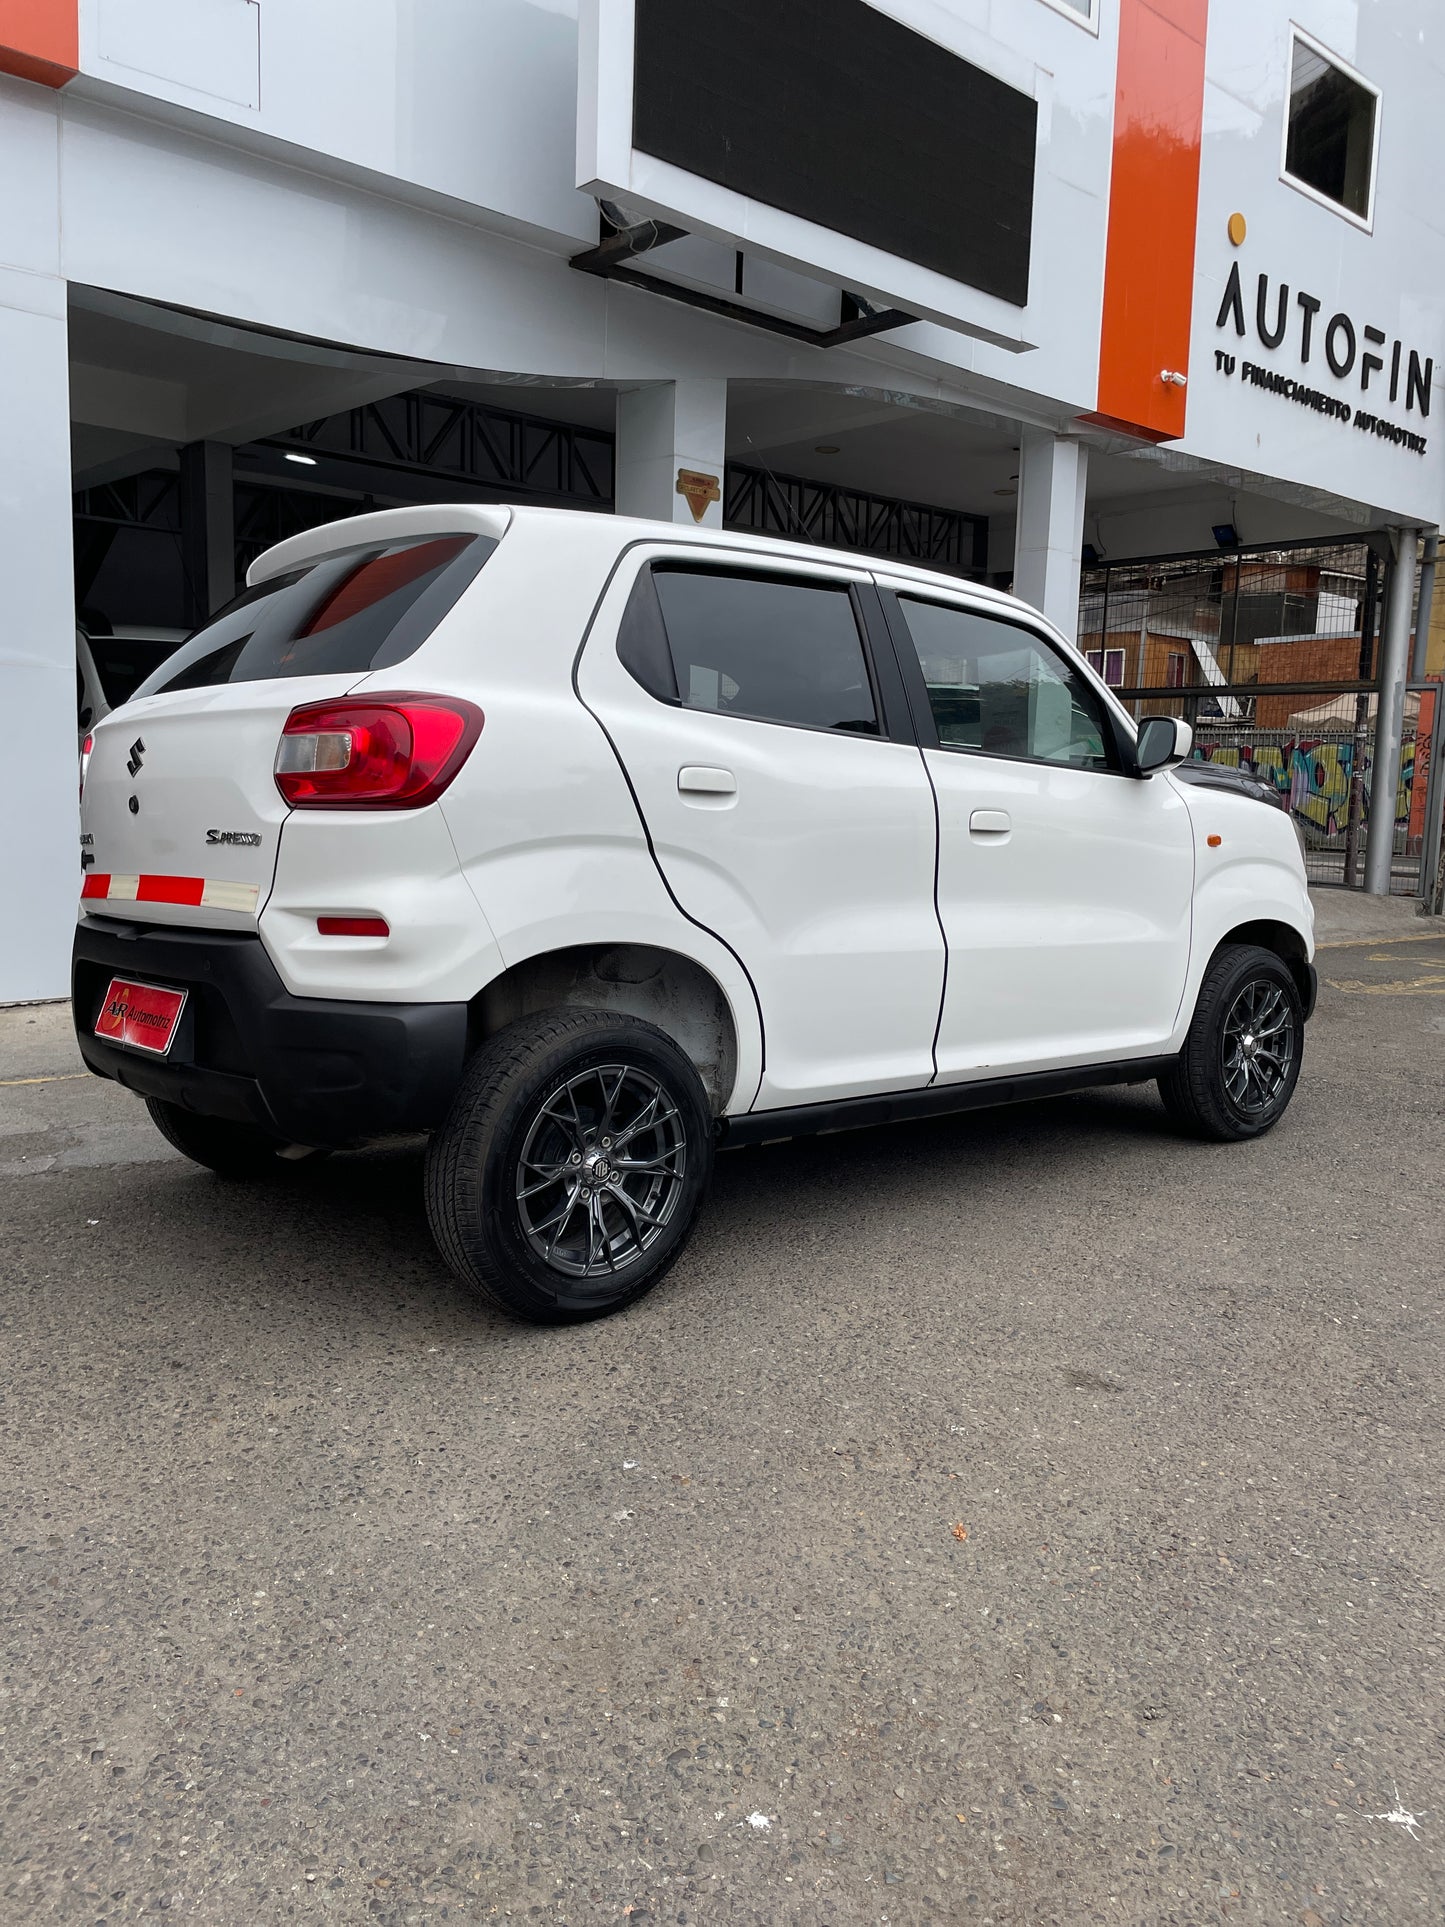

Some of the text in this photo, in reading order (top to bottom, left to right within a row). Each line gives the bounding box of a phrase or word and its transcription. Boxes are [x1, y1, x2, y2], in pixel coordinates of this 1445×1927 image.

[1215, 261, 1433, 417] AUTOFIN
[1214, 350, 1428, 454] TU FINANCIAMIENTO AUTOMOTRIZ
[127, 1006, 171, 1029] Automotriz
